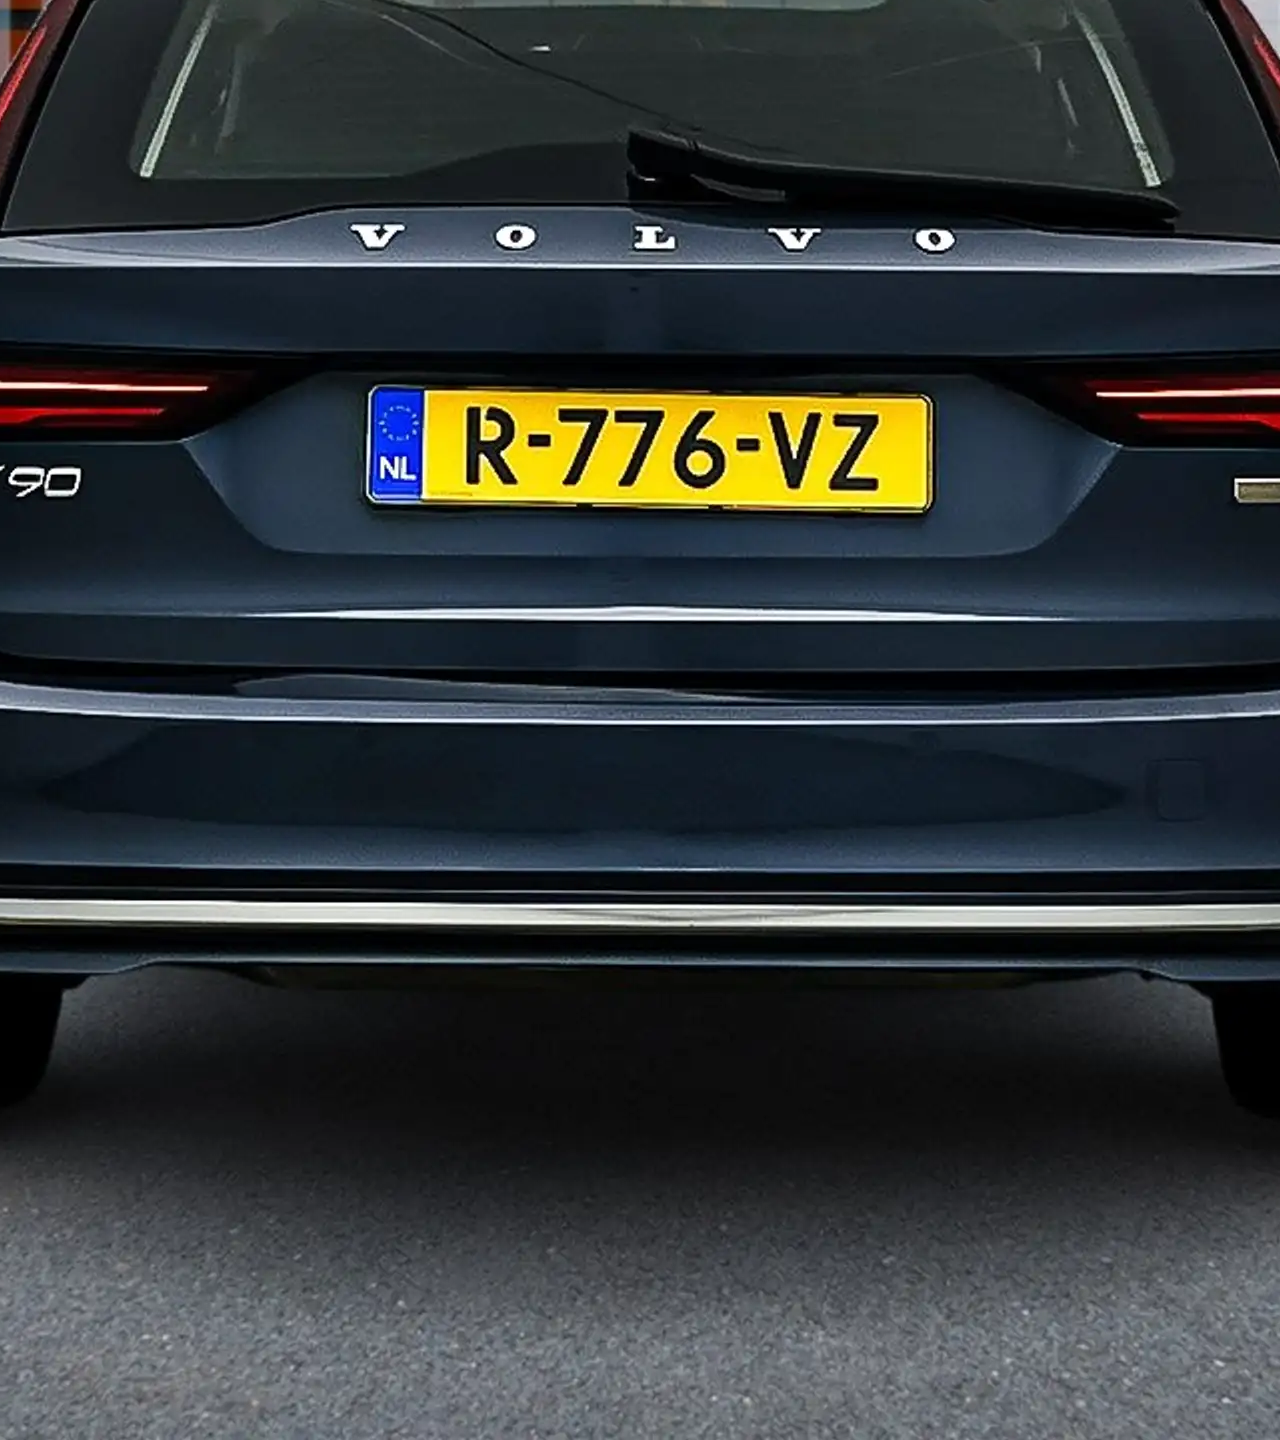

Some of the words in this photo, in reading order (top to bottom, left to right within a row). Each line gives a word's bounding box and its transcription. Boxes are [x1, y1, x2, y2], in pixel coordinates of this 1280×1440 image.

[351, 223, 956, 253] VOLVO
[465, 406, 880, 491] R-776-VZ
[379, 456, 417, 481] NL
